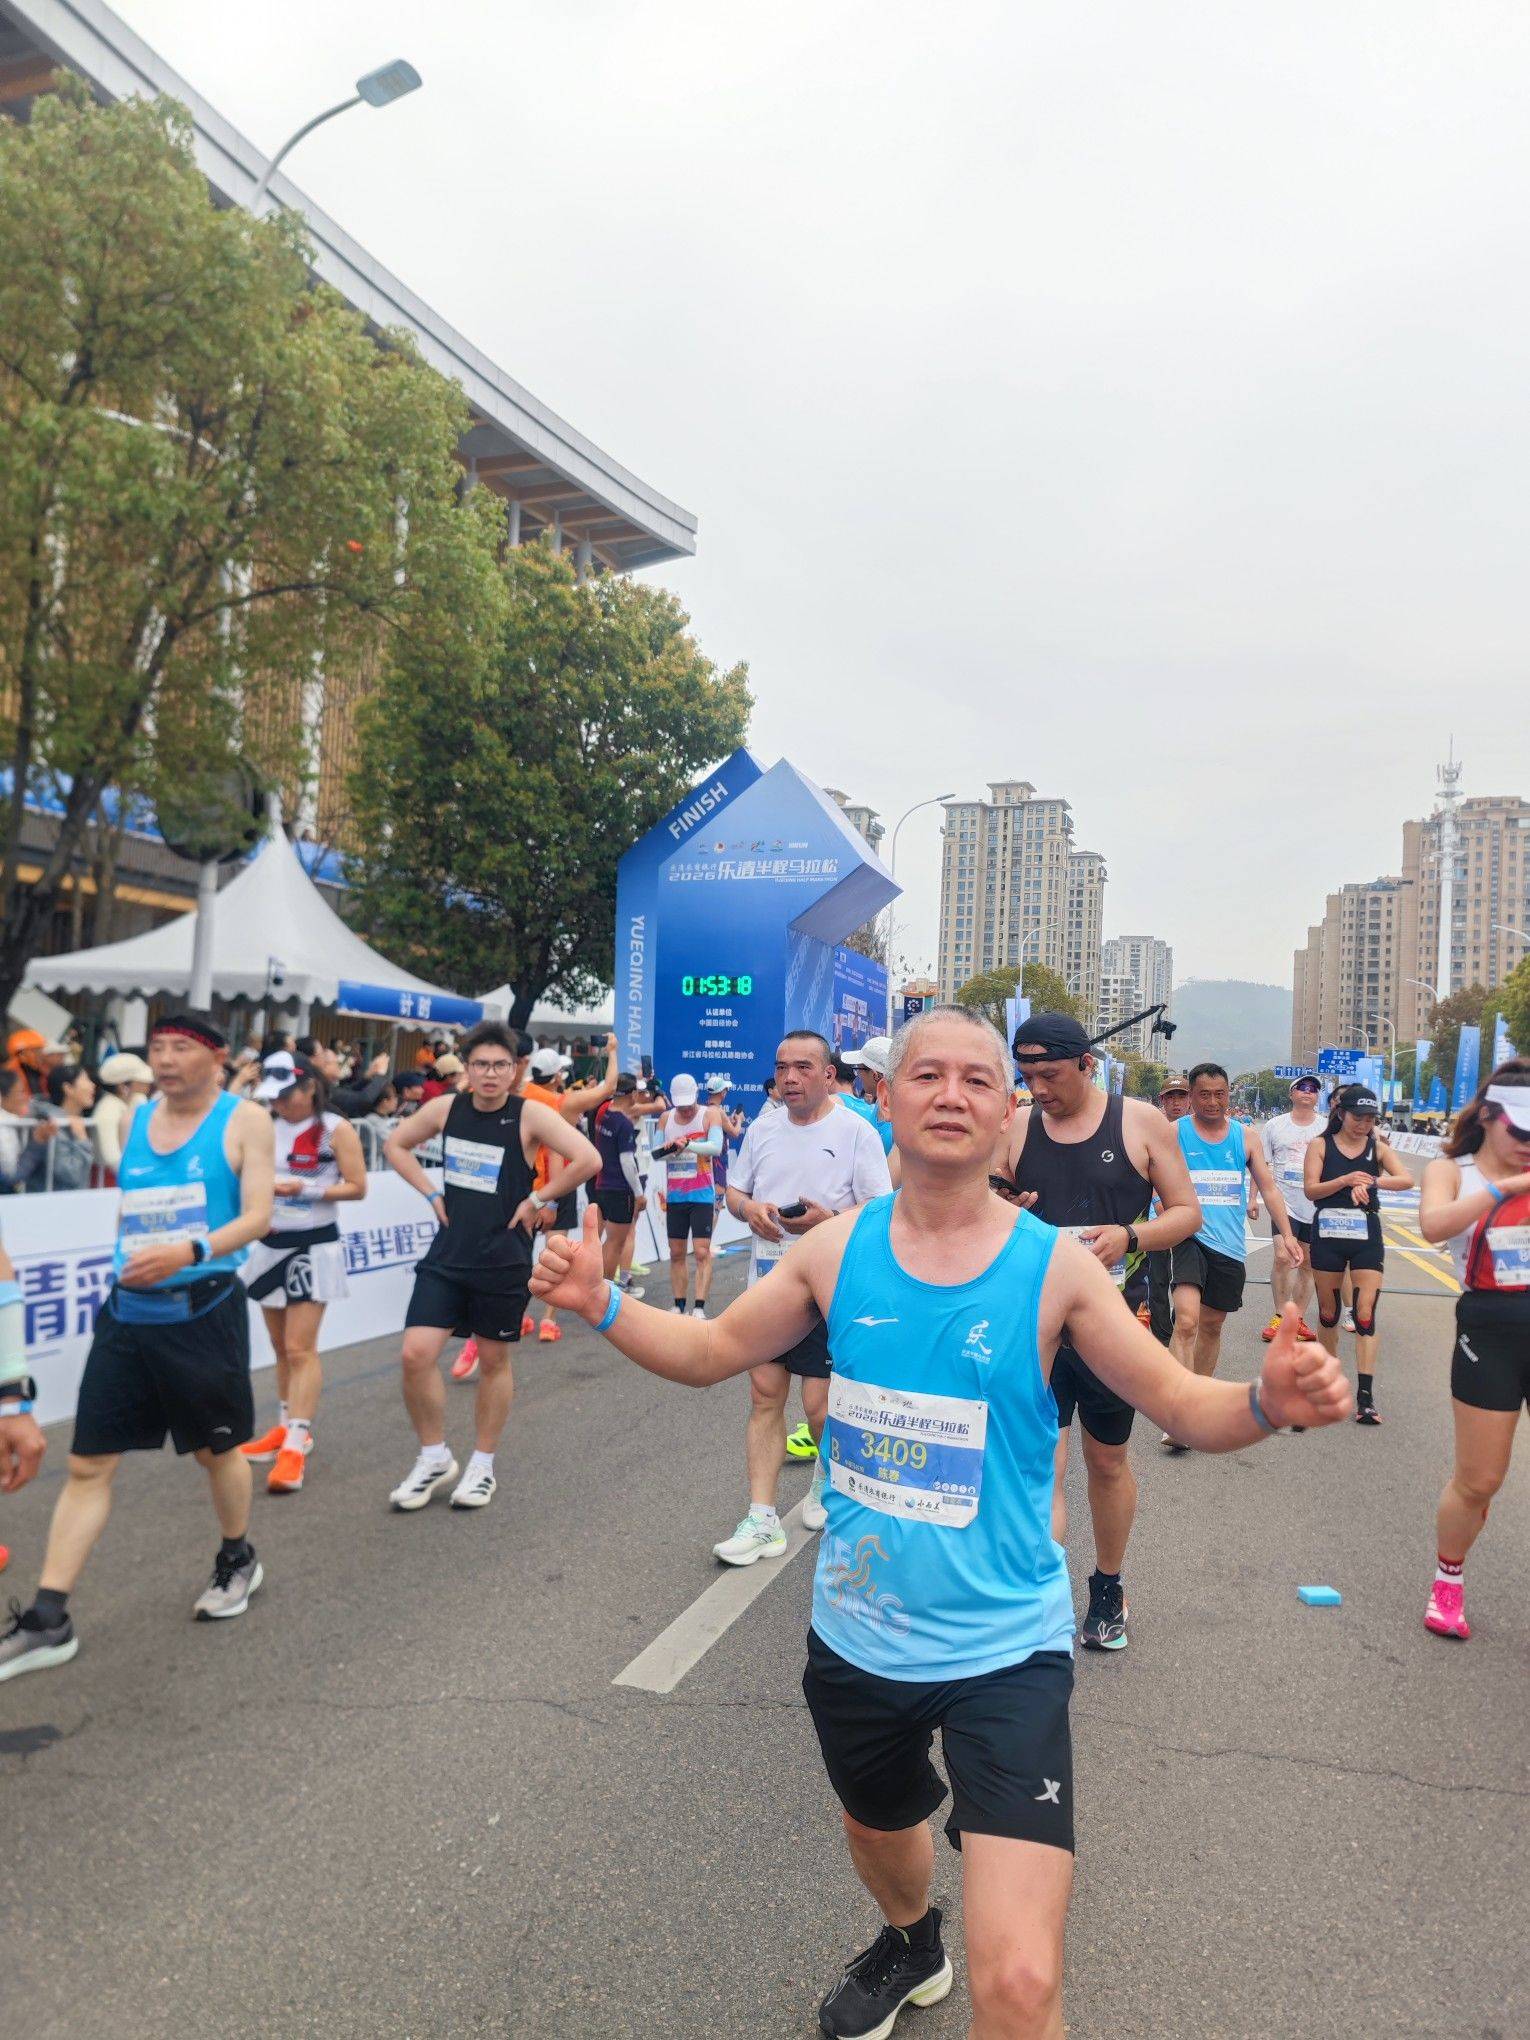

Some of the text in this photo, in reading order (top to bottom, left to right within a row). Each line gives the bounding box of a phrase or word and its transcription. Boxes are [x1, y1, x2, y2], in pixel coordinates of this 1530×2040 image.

[668, 781, 729, 840] FINISH
[629, 914, 646, 1002] YUEQING
[682, 975, 753, 996] 01:53:18
[698, 1019, 739, 1027] 中国田径协会
[705, 1008, 733, 1017] 认证单位
[626, 1005, 642, 1056] HALF
[831, 1437, 840, 1461] B
[860, 1430, 928, 1470] 3409
